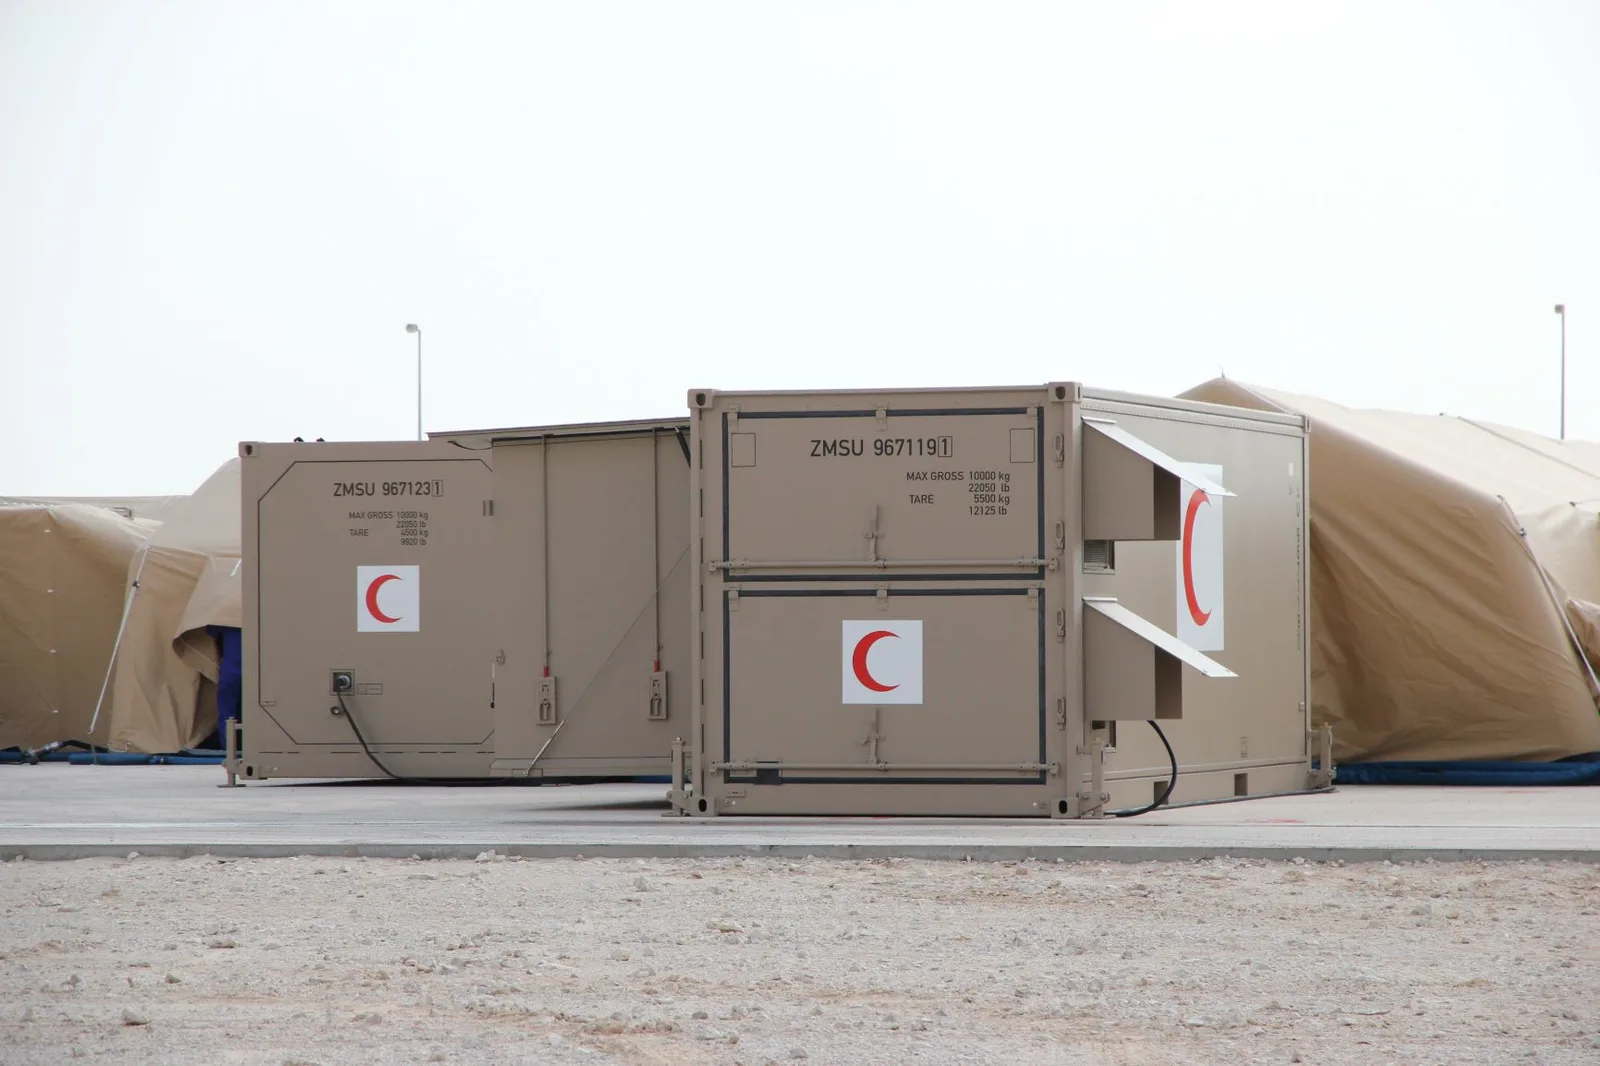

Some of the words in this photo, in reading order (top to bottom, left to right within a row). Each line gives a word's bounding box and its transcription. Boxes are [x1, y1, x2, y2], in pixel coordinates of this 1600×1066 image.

[810, 439, 864, 458] ZMSU
[906, 472, 929, 482] MAX
[930, 472, 965, 482] GROSS
[968, 471, 997, 482] 10000
[998, 471, 1011, 484] kg
[333, 482, 376, 497] ZMSU
[968, 482, 997, 493] 22050
[1000, 482, 1011, 493] lb
[908, 494, 935, 506] TARE
[973, 494, 997, 506] 5500
[998, 494, 1011, 507] kg
[348, 511, 366, 520] MAX
[367, 511, 394, 520] GROSS
[419, 511, 429, 521] kg
[968, 506, 997, 517] 12125
[998, 506, 1008, 517] lb
[419, 520, 427, 529] lb
[349, 528, 369, 537] TARE
[419, 528, 429, 538] kg
[419, 537, 427, 546] lb
